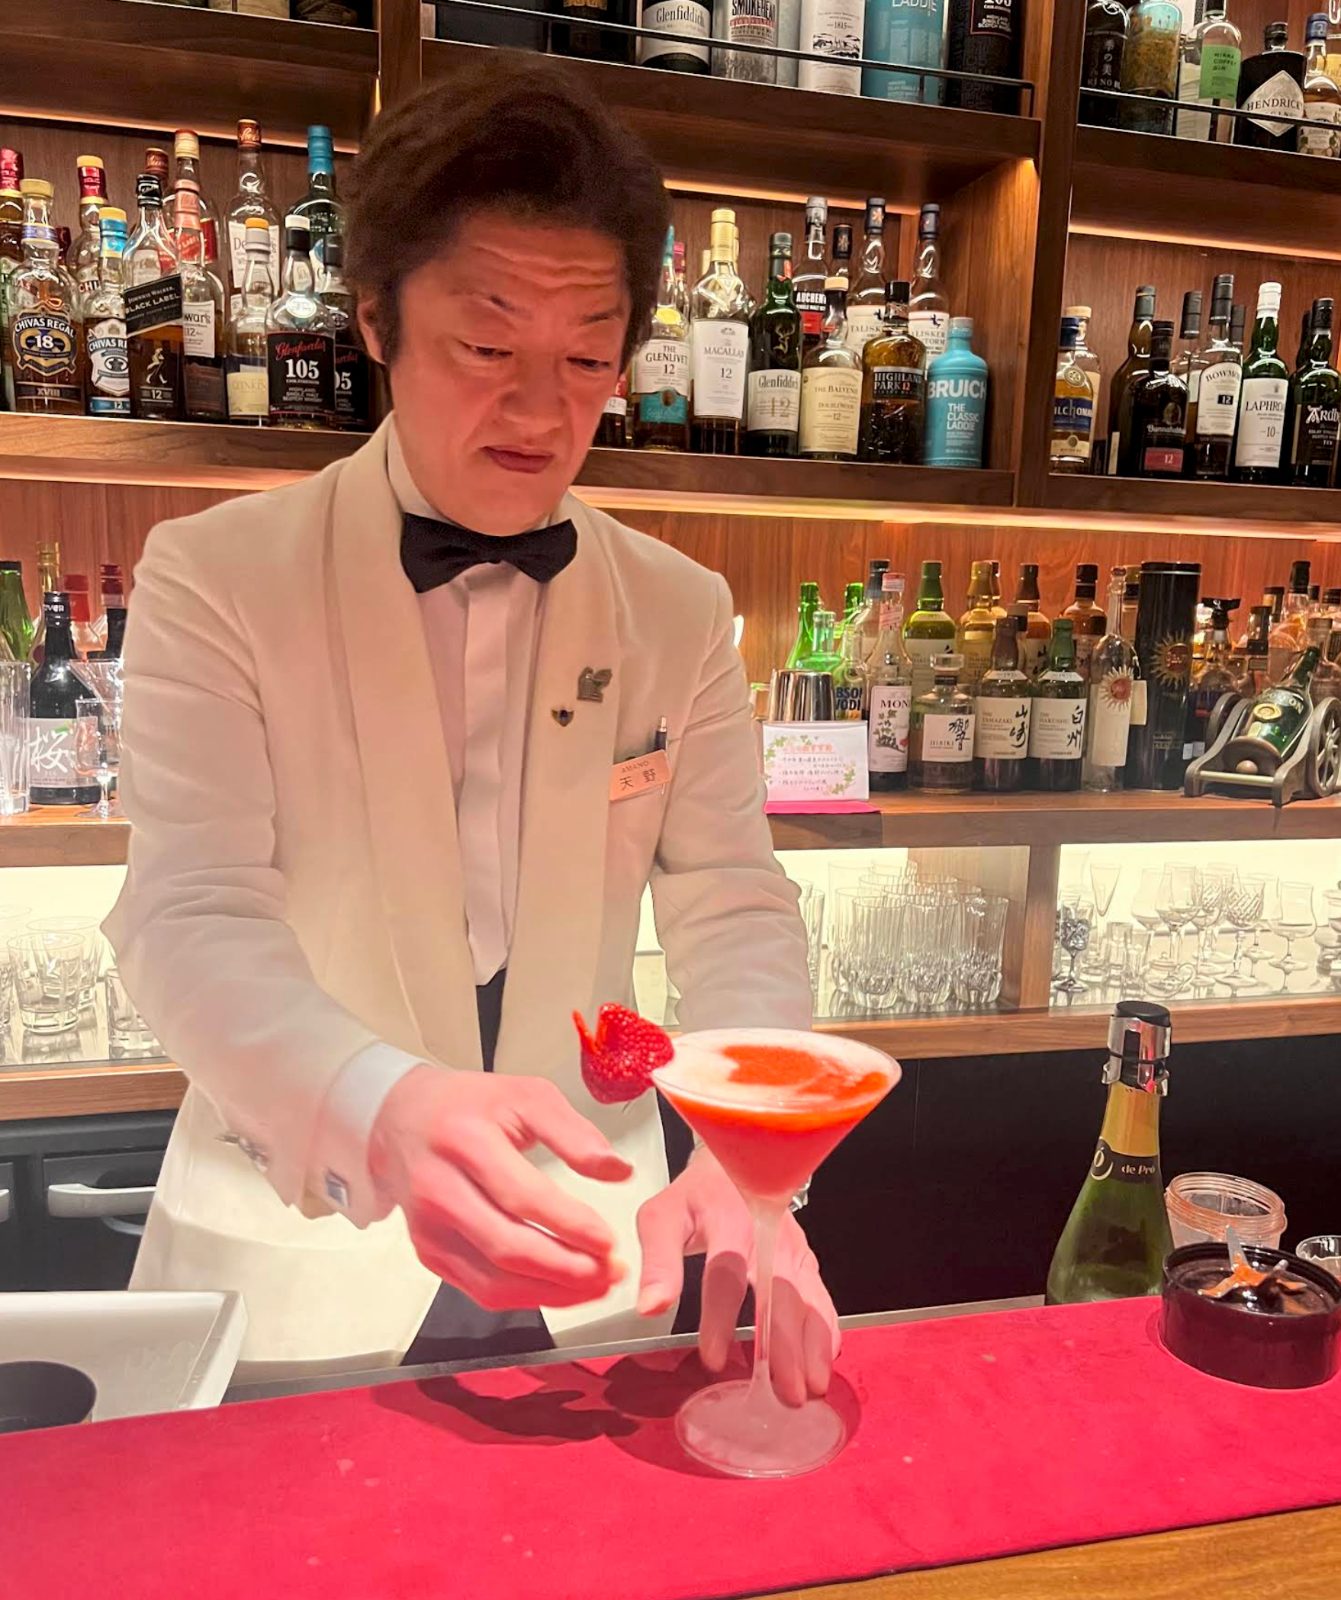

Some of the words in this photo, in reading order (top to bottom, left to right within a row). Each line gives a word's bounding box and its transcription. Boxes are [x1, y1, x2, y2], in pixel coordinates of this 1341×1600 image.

[152, 293, 181, 305] LABEL
[15, 318, 46, 333] CHIVAS
[47, 319, 75, 338] REGAL
[35, 335, 54, 349] 18
[89, 339, 116, 352] CHIVAS
[285, 358, 320, 380] 105
[663, 363, 675, 375] 12
[721, 367, 732, 379] 12
[874, 381, 900, 390] PARK
[902, 382, 911, 391] 12
[151, 389, 163, 400] 12
[1222, 395, 1231, 404] 12
[771, 397, 790, 418] 12
[948, 403, 966, 412] THE
[947, 421, 976, 431] LADDIE
[1266, 426, 1276, 438] 10
[1164, 454, 1173, 464] 12
[619, 768, 656, 791] 天野
